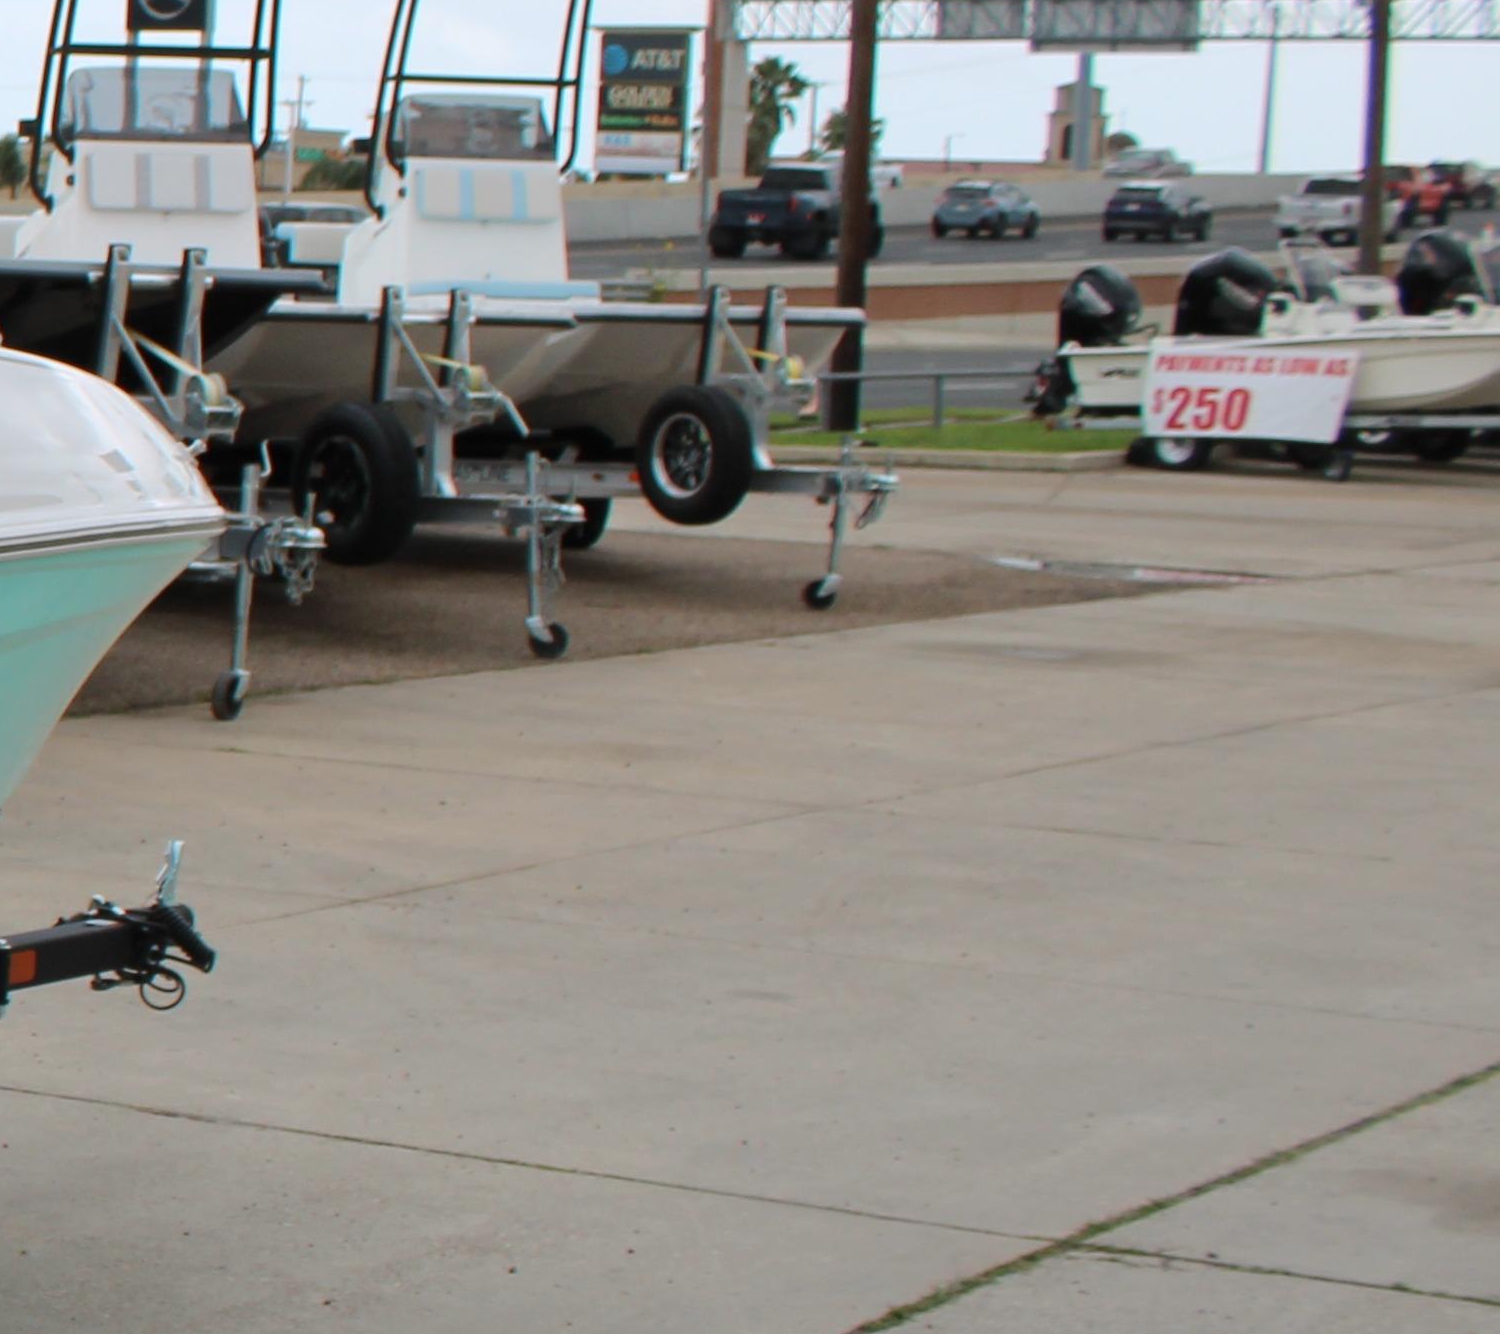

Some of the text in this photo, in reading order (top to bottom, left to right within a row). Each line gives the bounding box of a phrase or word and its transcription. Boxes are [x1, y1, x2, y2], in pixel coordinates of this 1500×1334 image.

[632, 47, 686, 70] AT&T
[1155, 354, 1246, 373] PAYMENTS
[1252, 356, 1275, 374] AS
[1280, 357, 1319, 375] LOW
[1322, 358, 1349, 376] AS
[1152, 386, 1252, 432] $250
